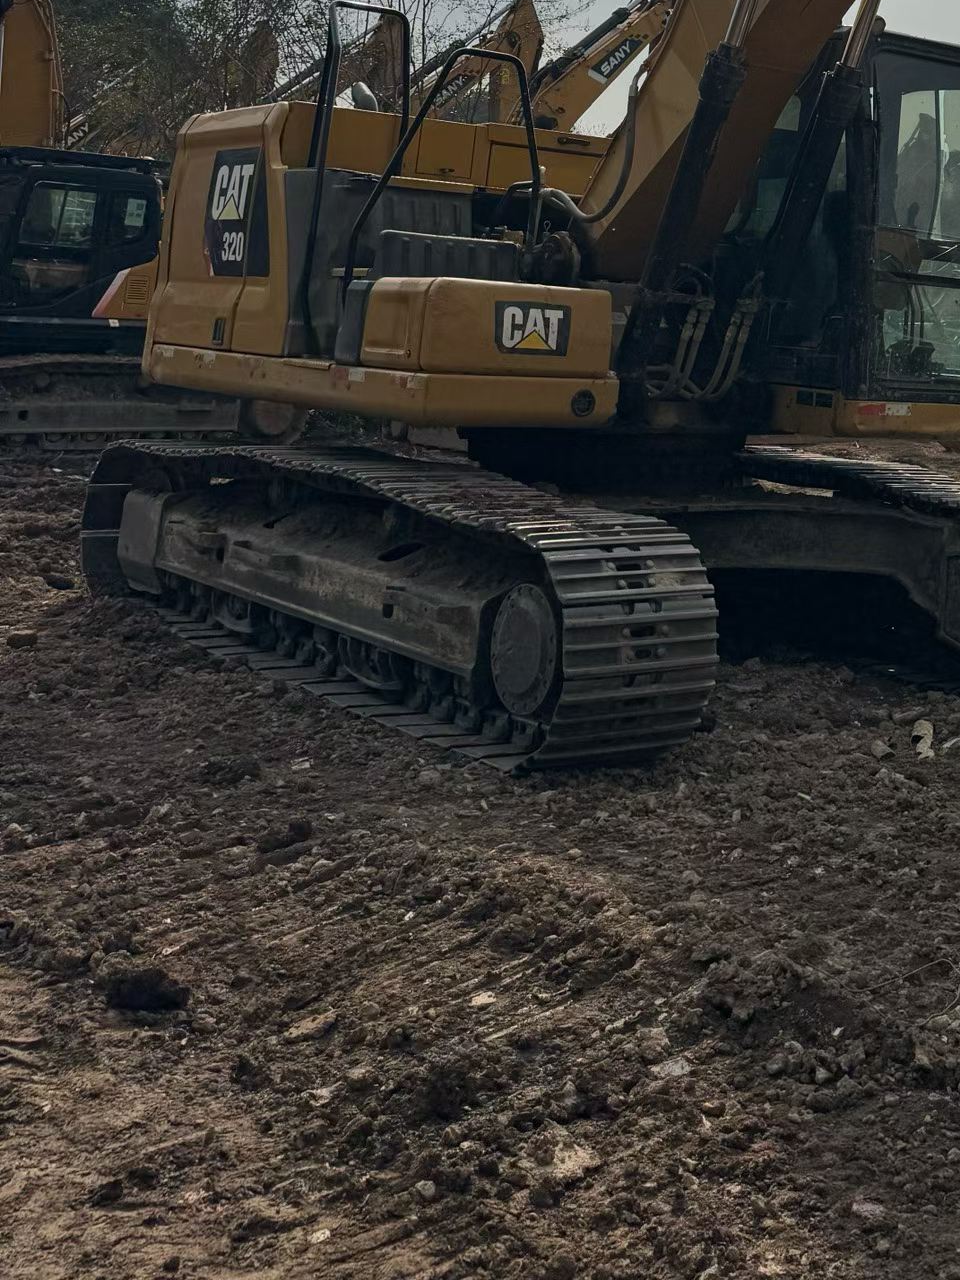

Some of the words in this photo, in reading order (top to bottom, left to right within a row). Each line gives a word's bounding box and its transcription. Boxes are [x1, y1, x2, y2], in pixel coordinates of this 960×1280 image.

[600, 41, 632, 76] SANY
[67, 122, 89, 146] ANY
[212, 163, 254, 220] CAT
[222, 231, 245, 262] 320
[502, 306, 564, 350] CAT
